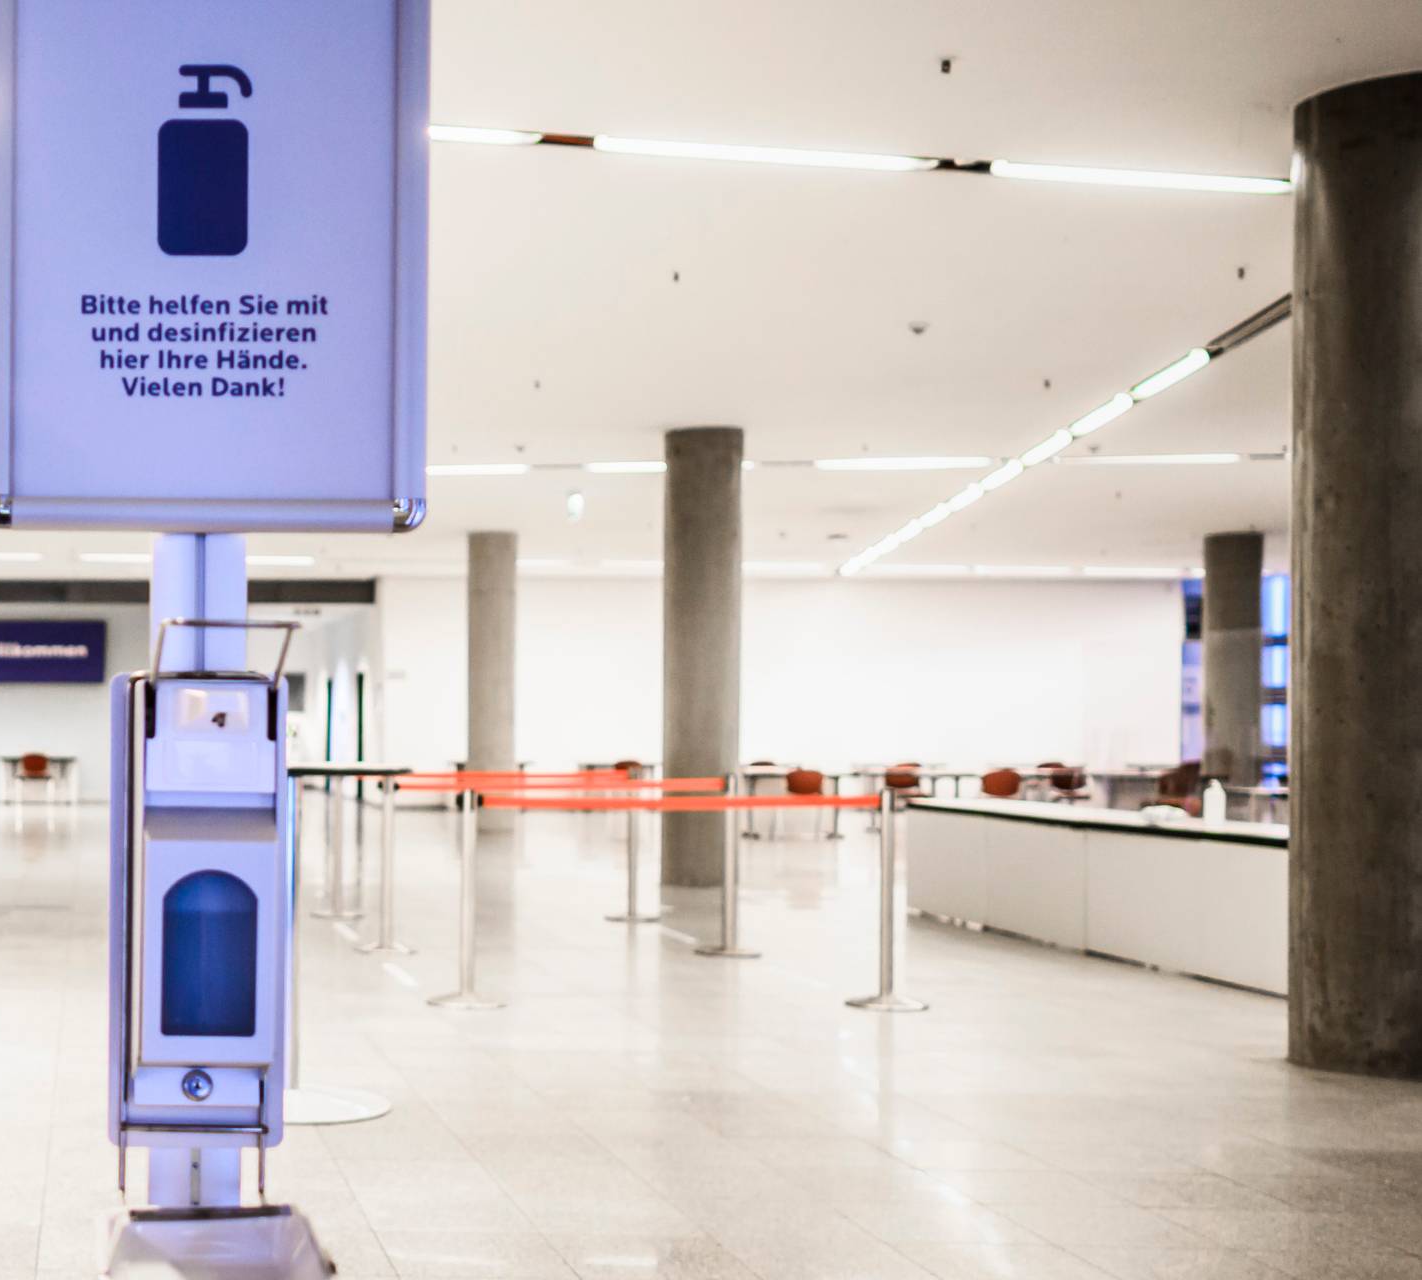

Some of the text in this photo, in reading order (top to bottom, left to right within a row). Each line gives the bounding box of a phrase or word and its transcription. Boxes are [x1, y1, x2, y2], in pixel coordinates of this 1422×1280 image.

[81, 294, 328, 315] Bitte helfen Sie mit
[91, 322, 317, 343] und desinfizieren
[99, 349, 307, 370] hier Ihre Hände.
[121, 376, 285, 398] Vielen Dank!
